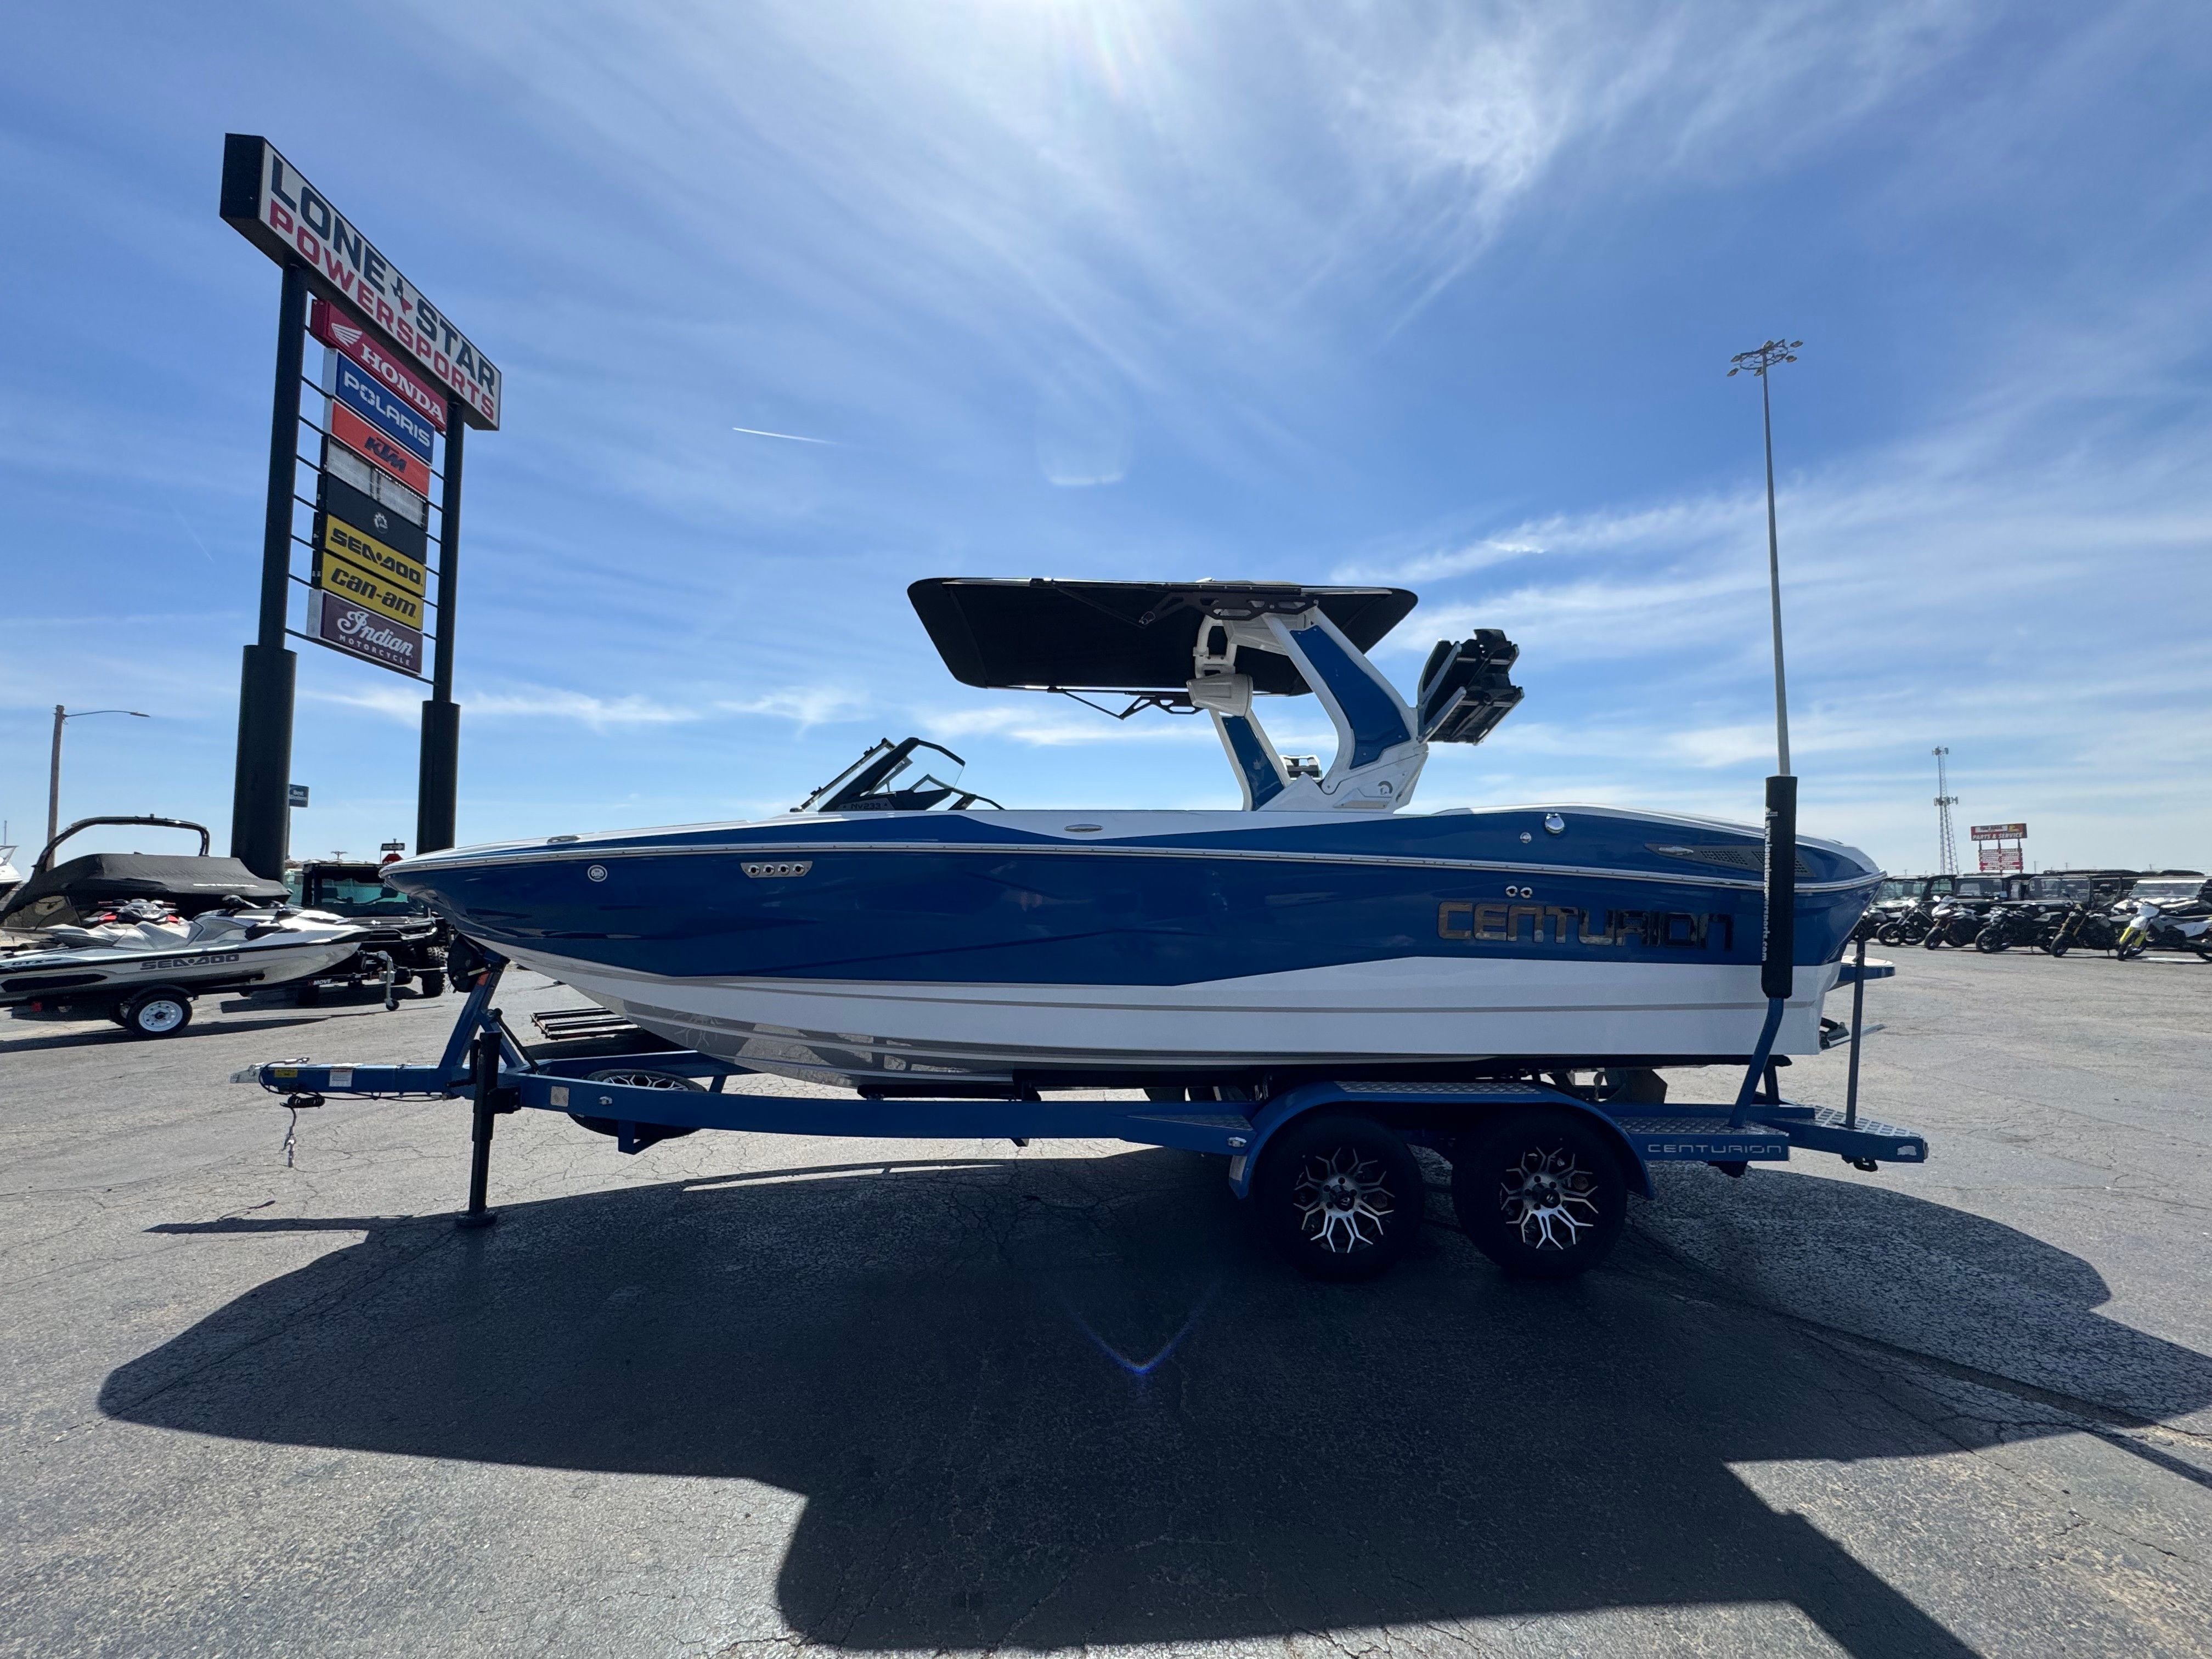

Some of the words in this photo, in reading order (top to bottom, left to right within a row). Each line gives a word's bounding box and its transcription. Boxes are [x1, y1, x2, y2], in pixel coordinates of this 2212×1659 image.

[272, 154, 386, 295] LONE
[416, 298, 494, 397] STAR
[270, 199, 494, 420] POWERSPORTS
[362, 344, 445, 424] HONDA
[344, 373, 431, 447] POLARIS
[364, 436, 407, 473] KTM
[337, 611, 414, 656] Indian
[339, 634, 410, 665] MOTORCYCLE
[1437, 902, 1734, 951] CENTURION
[1647, 1144, 1782, 1154] CENTURION
